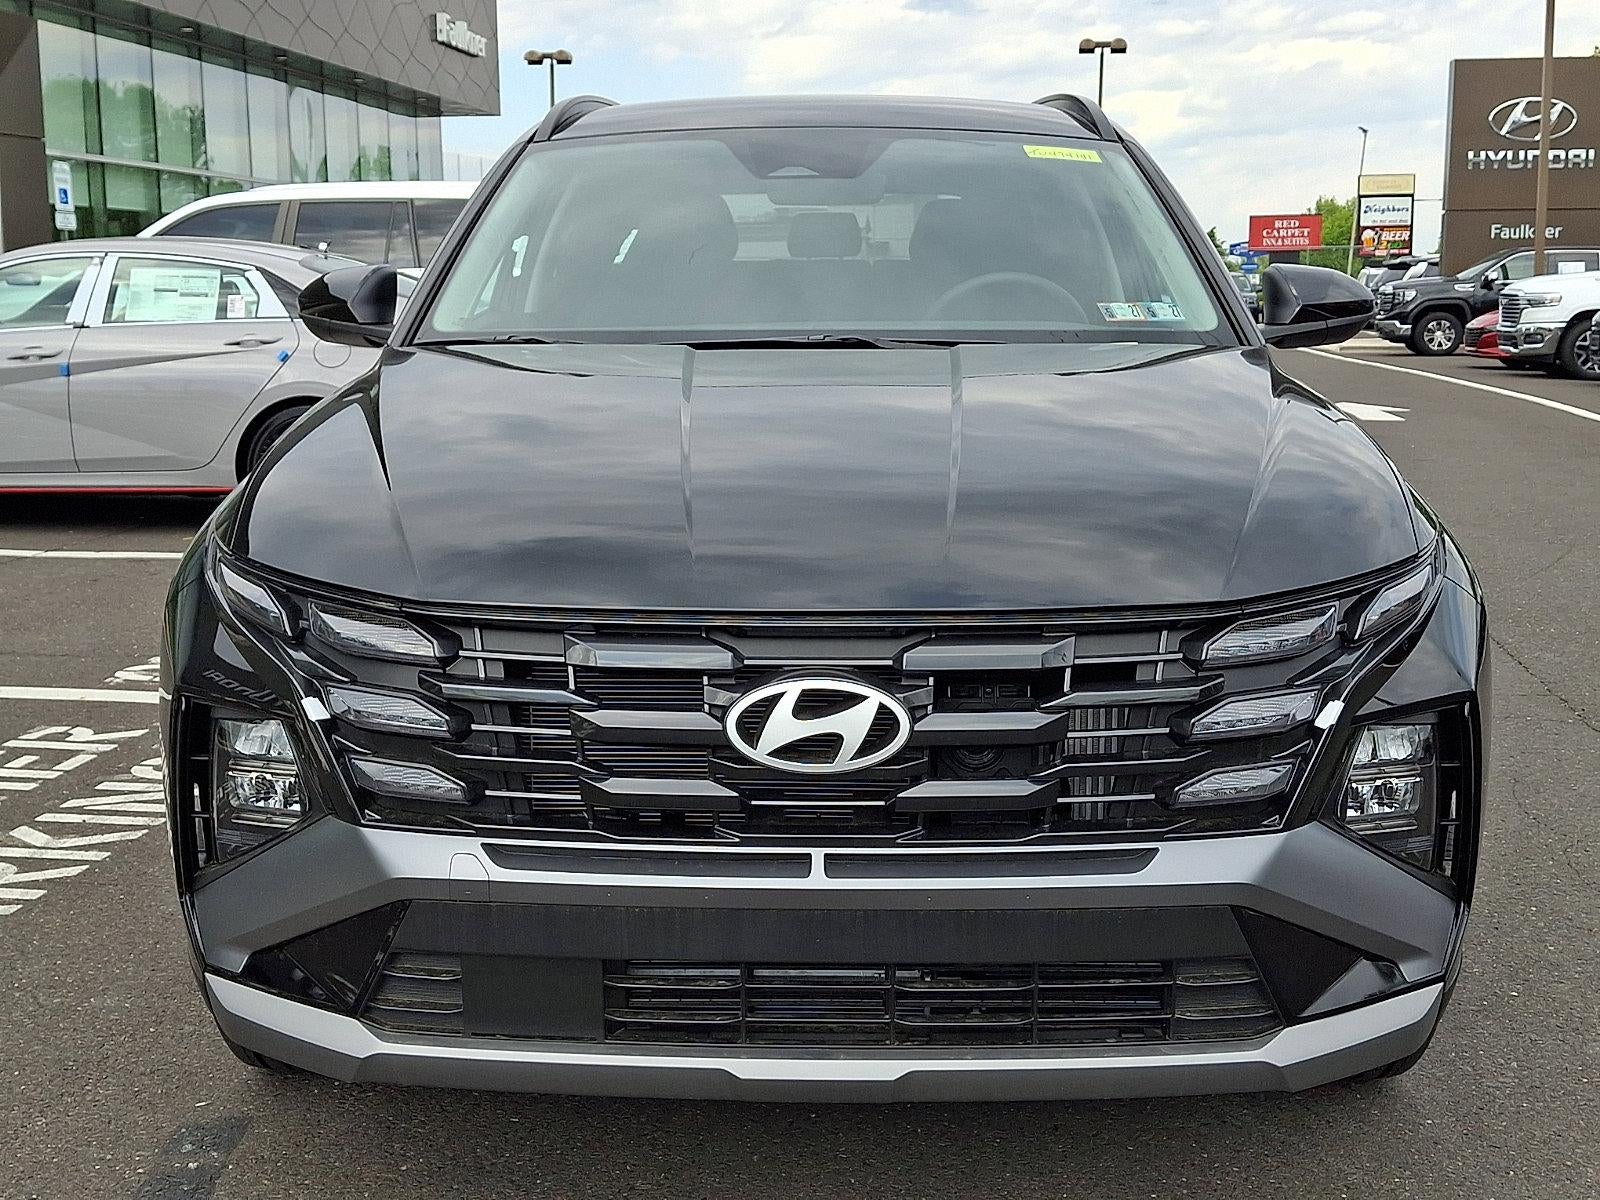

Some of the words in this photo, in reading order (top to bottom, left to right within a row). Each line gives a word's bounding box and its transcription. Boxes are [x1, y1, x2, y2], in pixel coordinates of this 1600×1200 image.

[1275, 220, 1300, 228] RED
[1262, 228, 1310, 237] CARPET
[1381, 231, 1410, 241] BEER
[1490, 224, 1563, 239] Faulker
